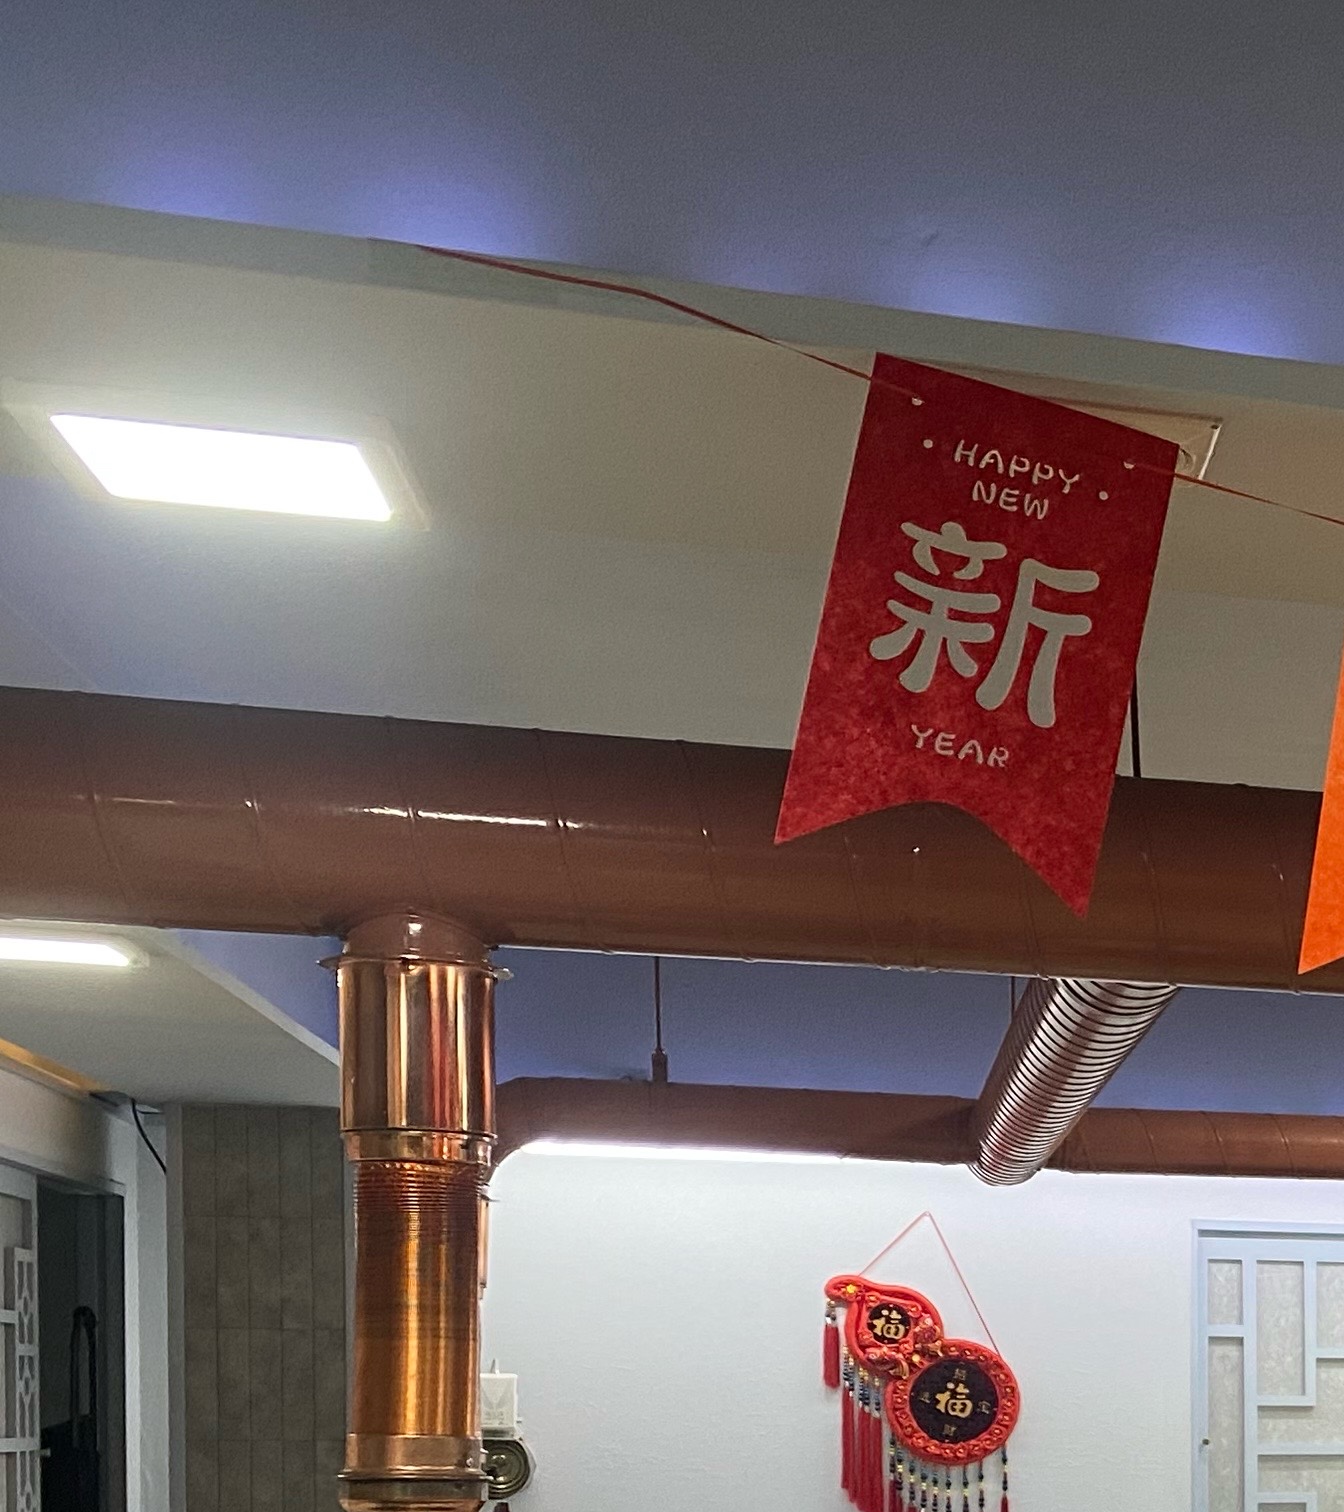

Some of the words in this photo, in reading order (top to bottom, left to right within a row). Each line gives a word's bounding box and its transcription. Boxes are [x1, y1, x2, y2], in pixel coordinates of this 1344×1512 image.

[953, 440, 1080, 495] HAPPY
[971, 480, 1050, 520] NEW
[869, 521, 1100, 728] 新
[911, 724, 1010, 767] YEAR
